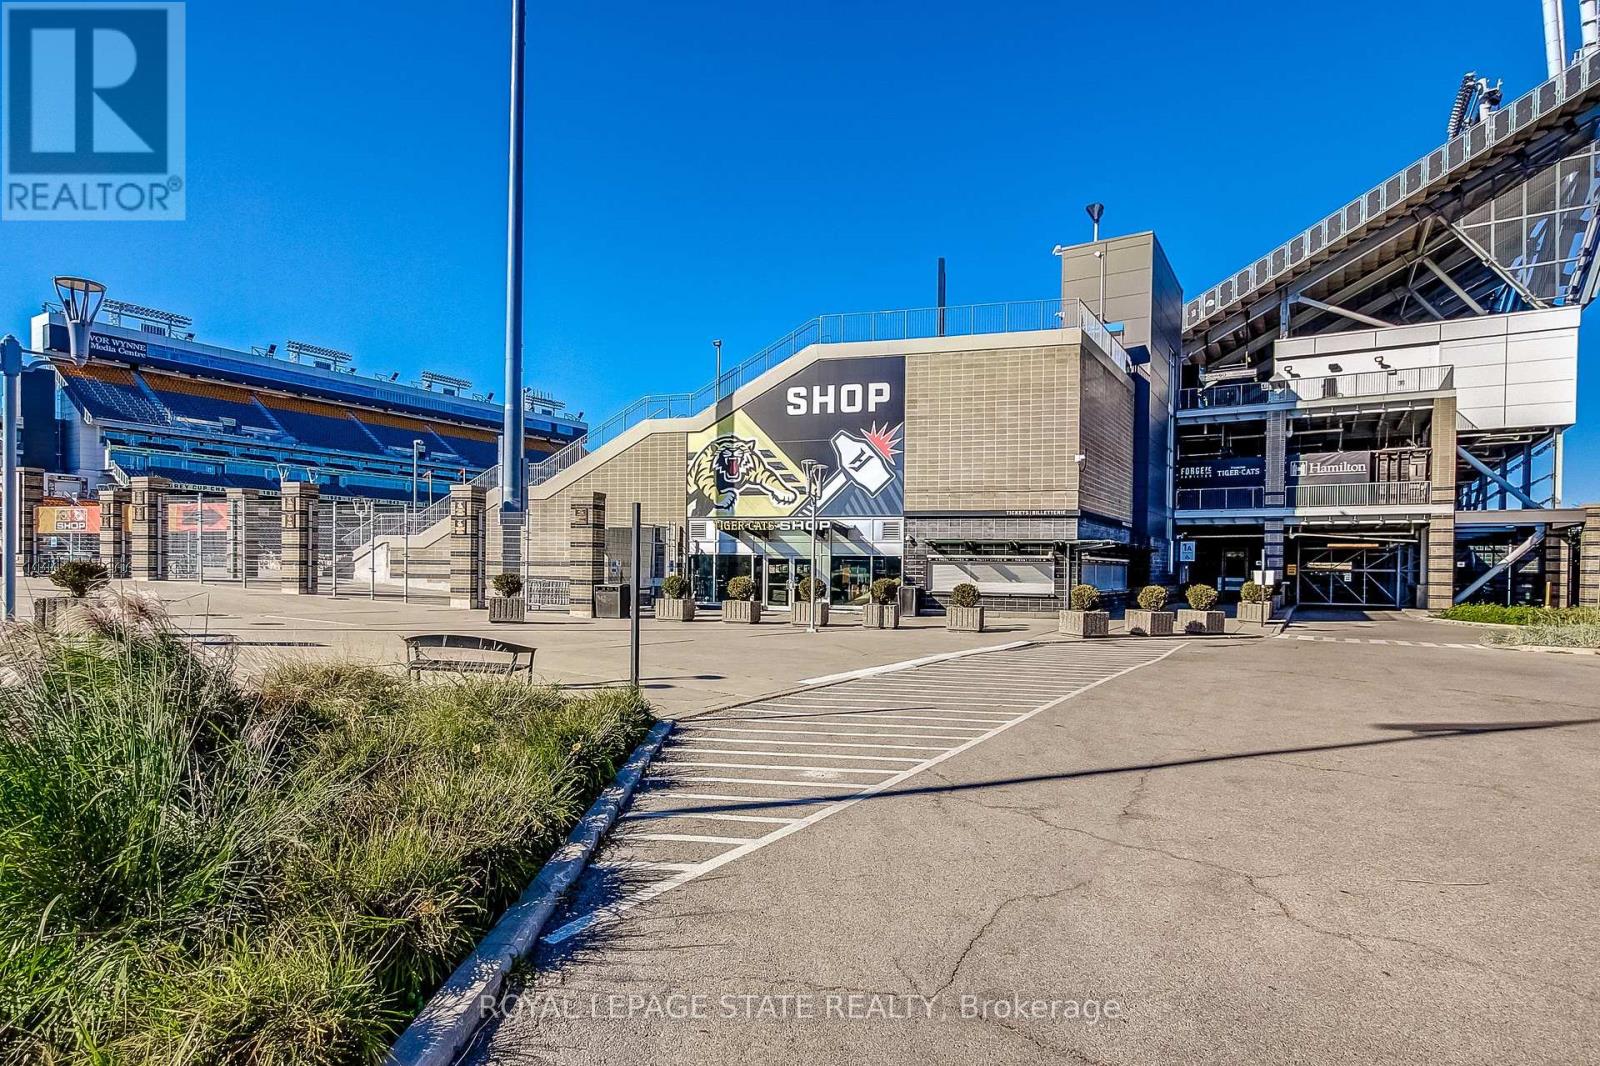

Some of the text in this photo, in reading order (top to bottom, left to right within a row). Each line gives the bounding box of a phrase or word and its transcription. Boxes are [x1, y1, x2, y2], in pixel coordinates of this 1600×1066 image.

[90, 342, 146, 358] Media Centre
[111, 339, 146, 352] WYNNE
[786, 382, 891, 416] SHOP
[1181, 466, 1204, 475] FORGE
[1309, 461, 1366, 473] Hamilton
[1217, 468, 1260, 477] TIGER-CATS
[56, 522, 86, 530] SHOP
[779, 520, 831, 530] SHOP
[1182, 543, 1193, 552] 1A
